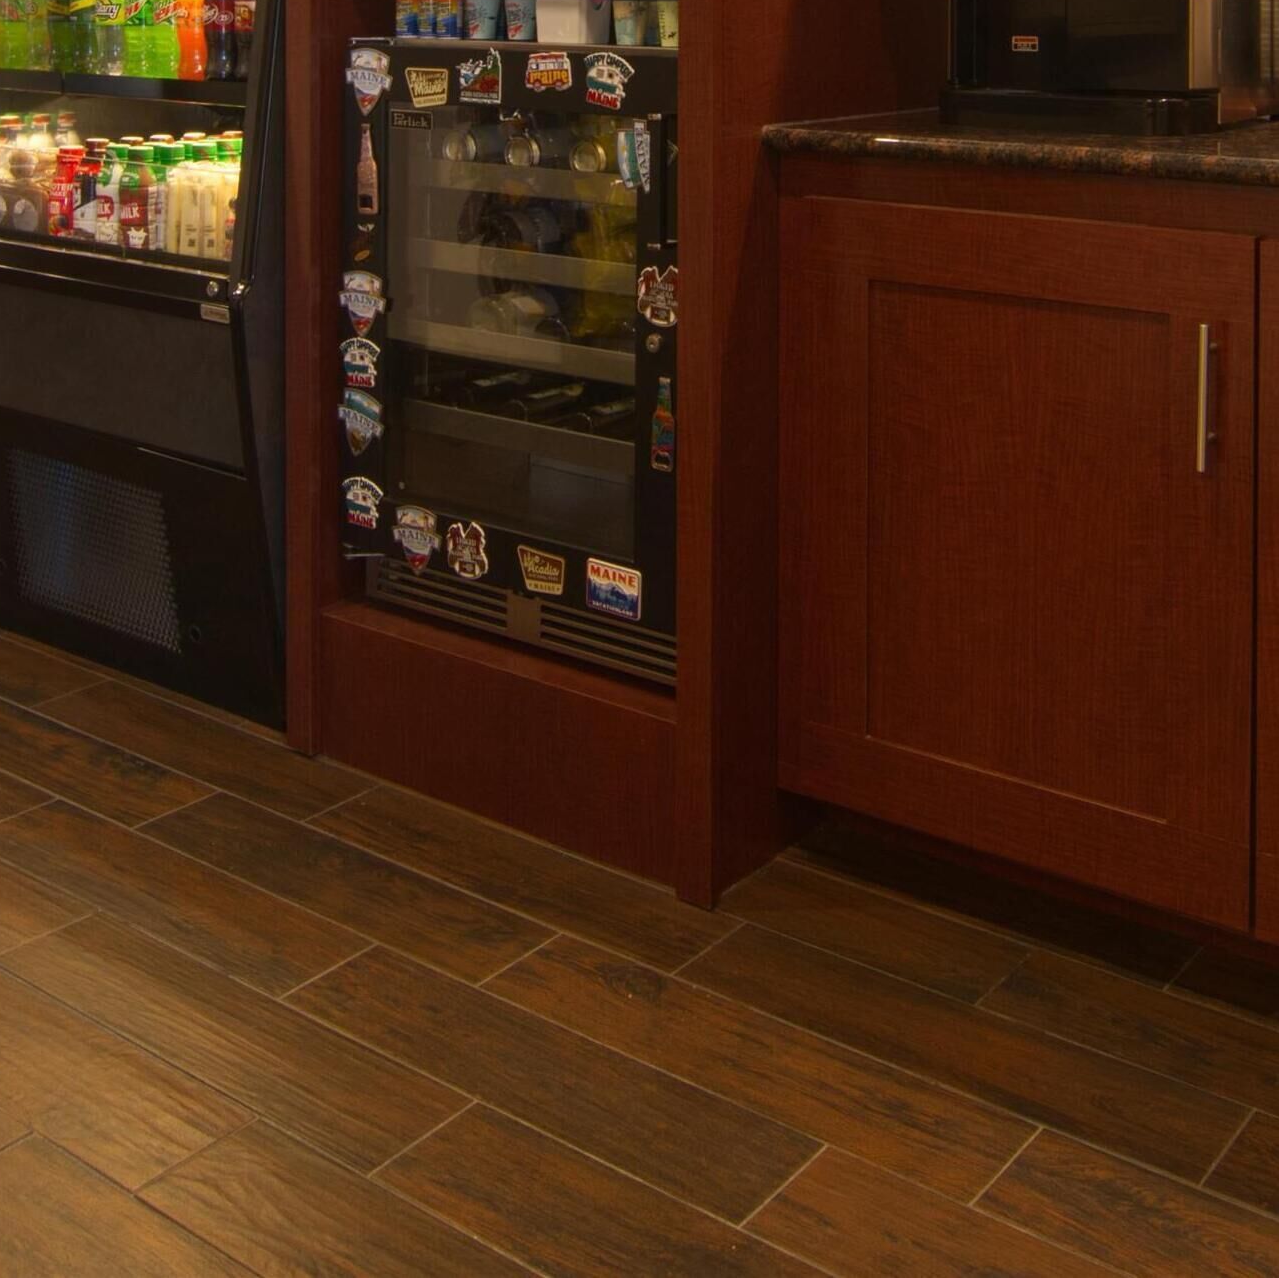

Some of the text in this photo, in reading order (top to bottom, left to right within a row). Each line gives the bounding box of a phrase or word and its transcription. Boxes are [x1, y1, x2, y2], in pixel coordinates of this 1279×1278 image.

[349, 72, 387, 85] MAINE
[392, 113, 429, 128] Perlick
[343, 294, 381, 308] MAINE
[397, 530, 436, 546] MAINE
[590, 565, 637, 587] MAINE
